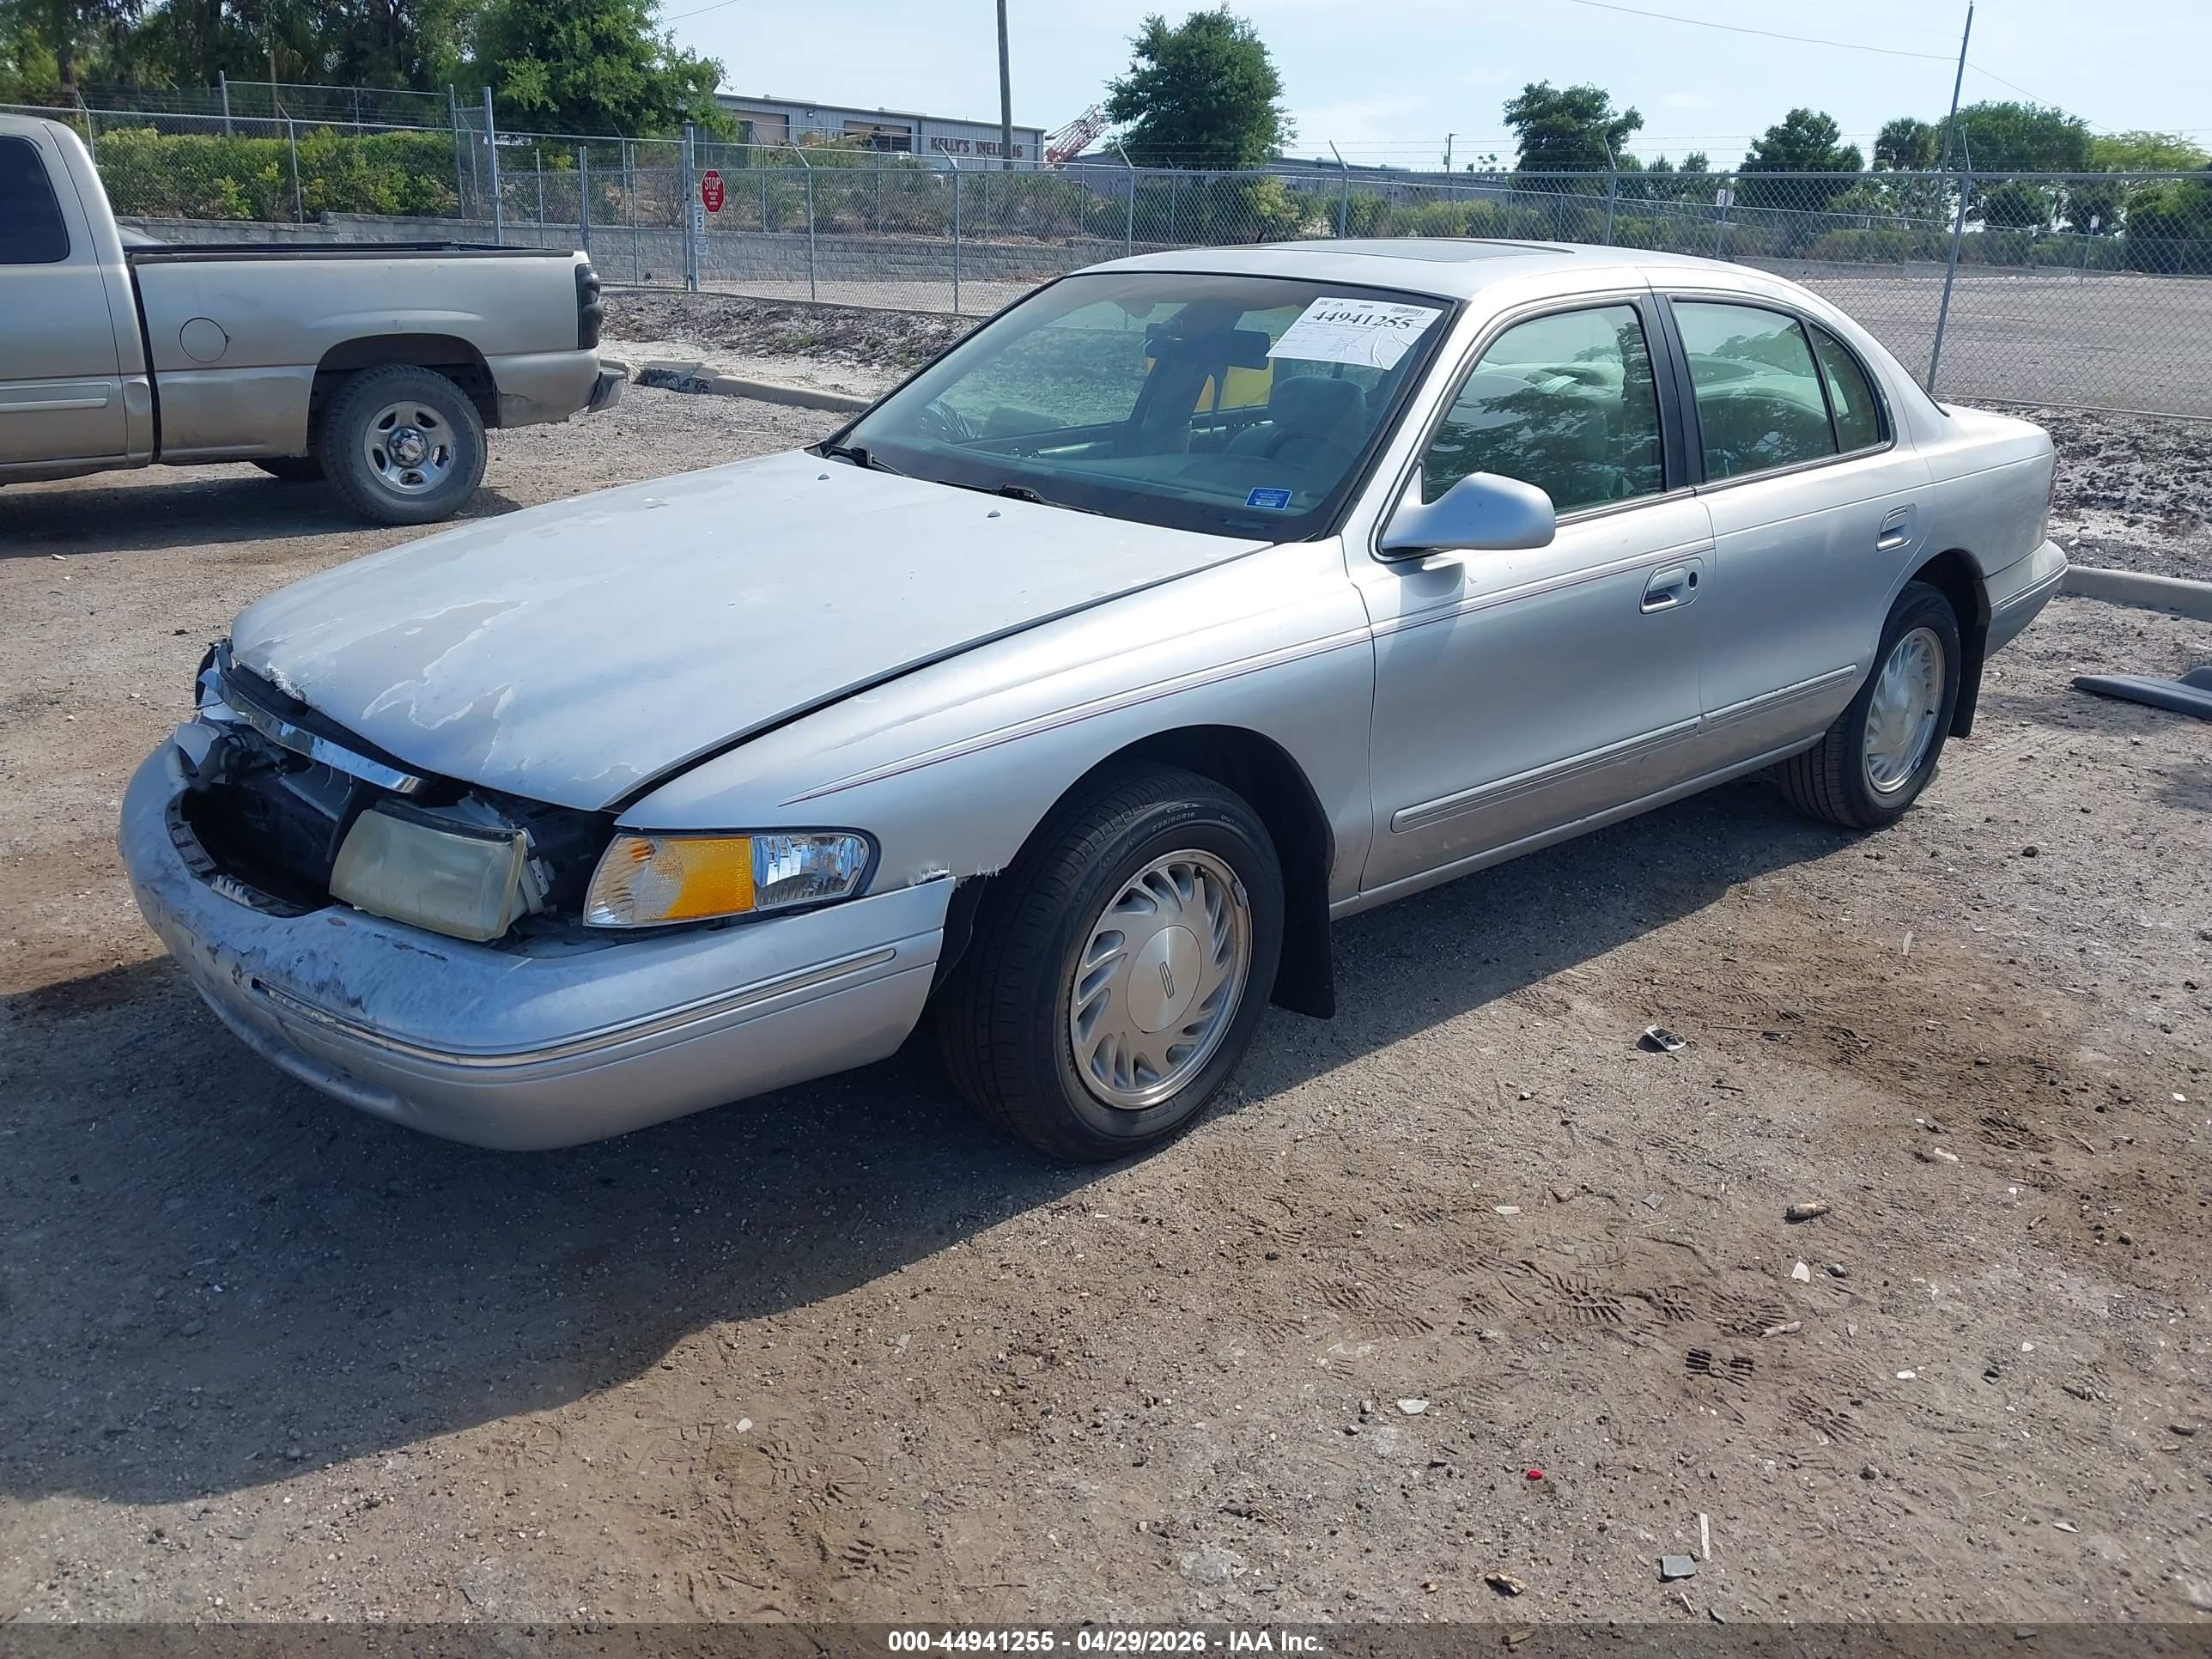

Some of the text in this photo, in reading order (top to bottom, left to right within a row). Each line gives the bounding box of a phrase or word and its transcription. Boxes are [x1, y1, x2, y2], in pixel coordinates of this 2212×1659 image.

[704, 176, 720, 191] STOP
[697, 216, 702, 228] 5
[1312, 310, 1415, 330] 44941255
